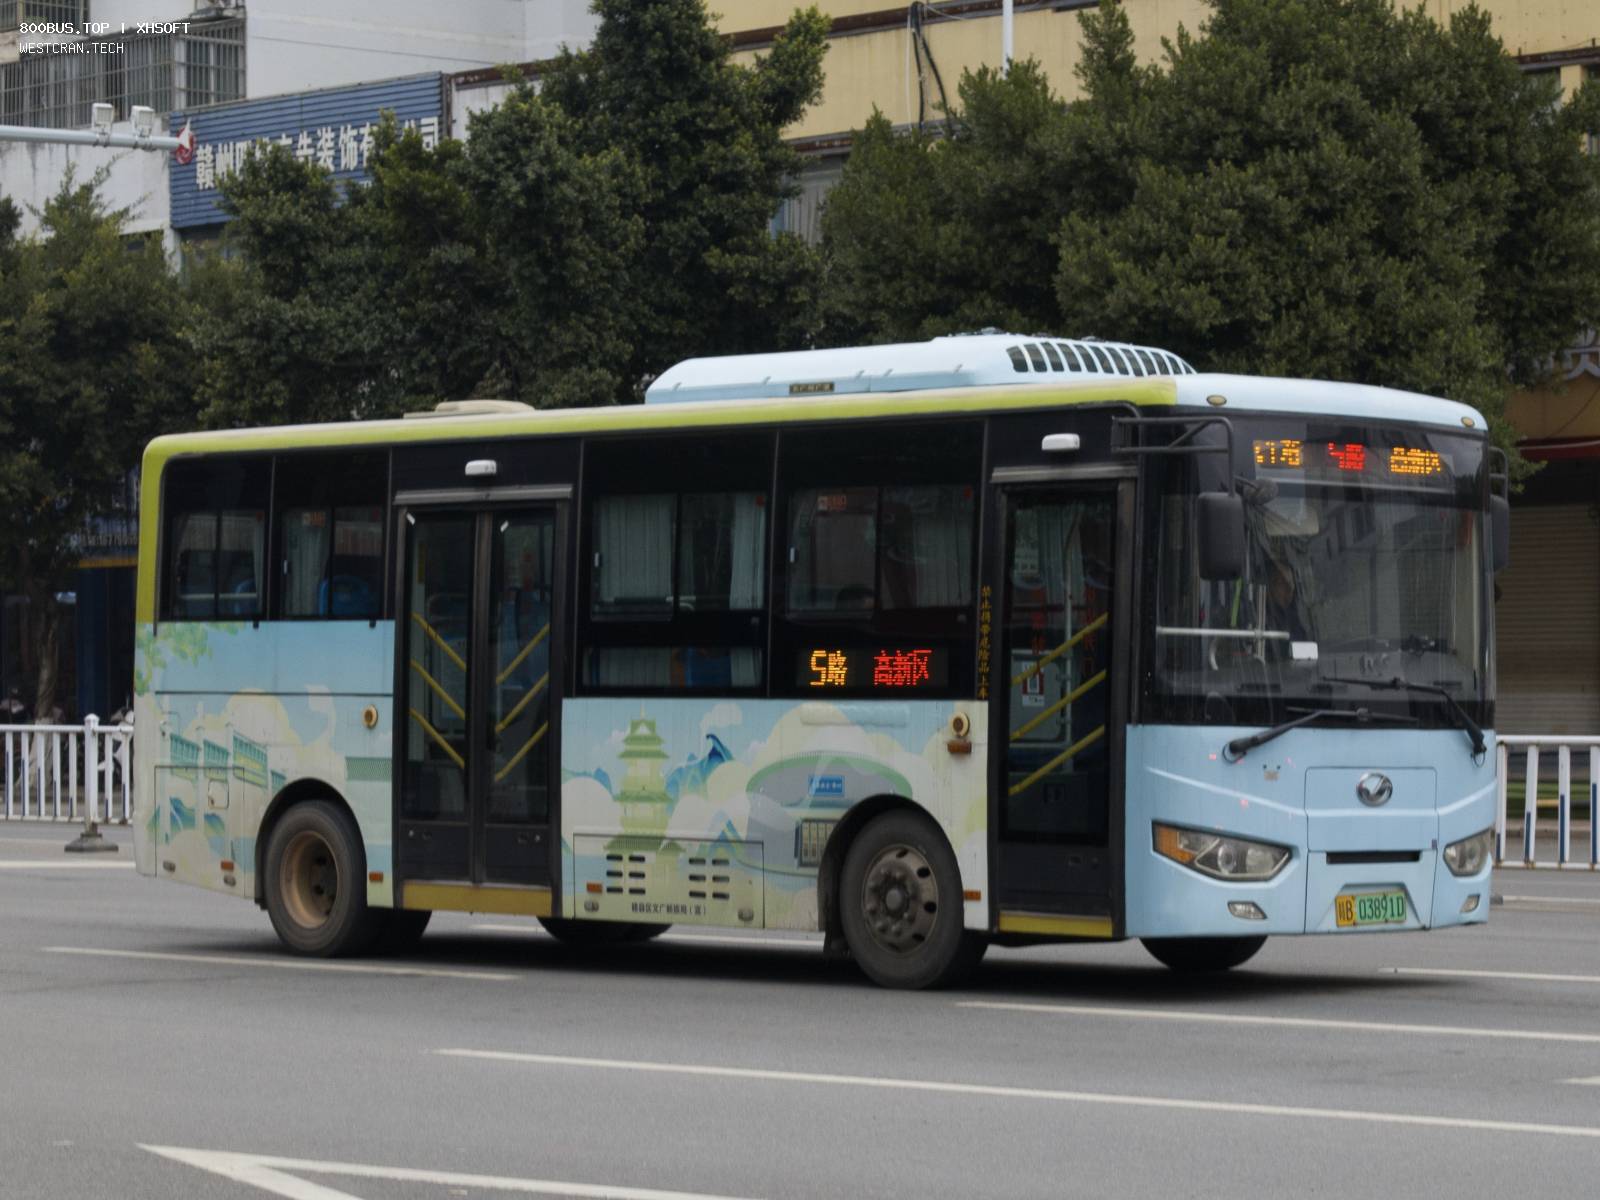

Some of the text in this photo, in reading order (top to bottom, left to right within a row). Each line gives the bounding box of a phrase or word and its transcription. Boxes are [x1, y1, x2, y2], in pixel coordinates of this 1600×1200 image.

[809, 649, 933, 685] 5路 高新区
